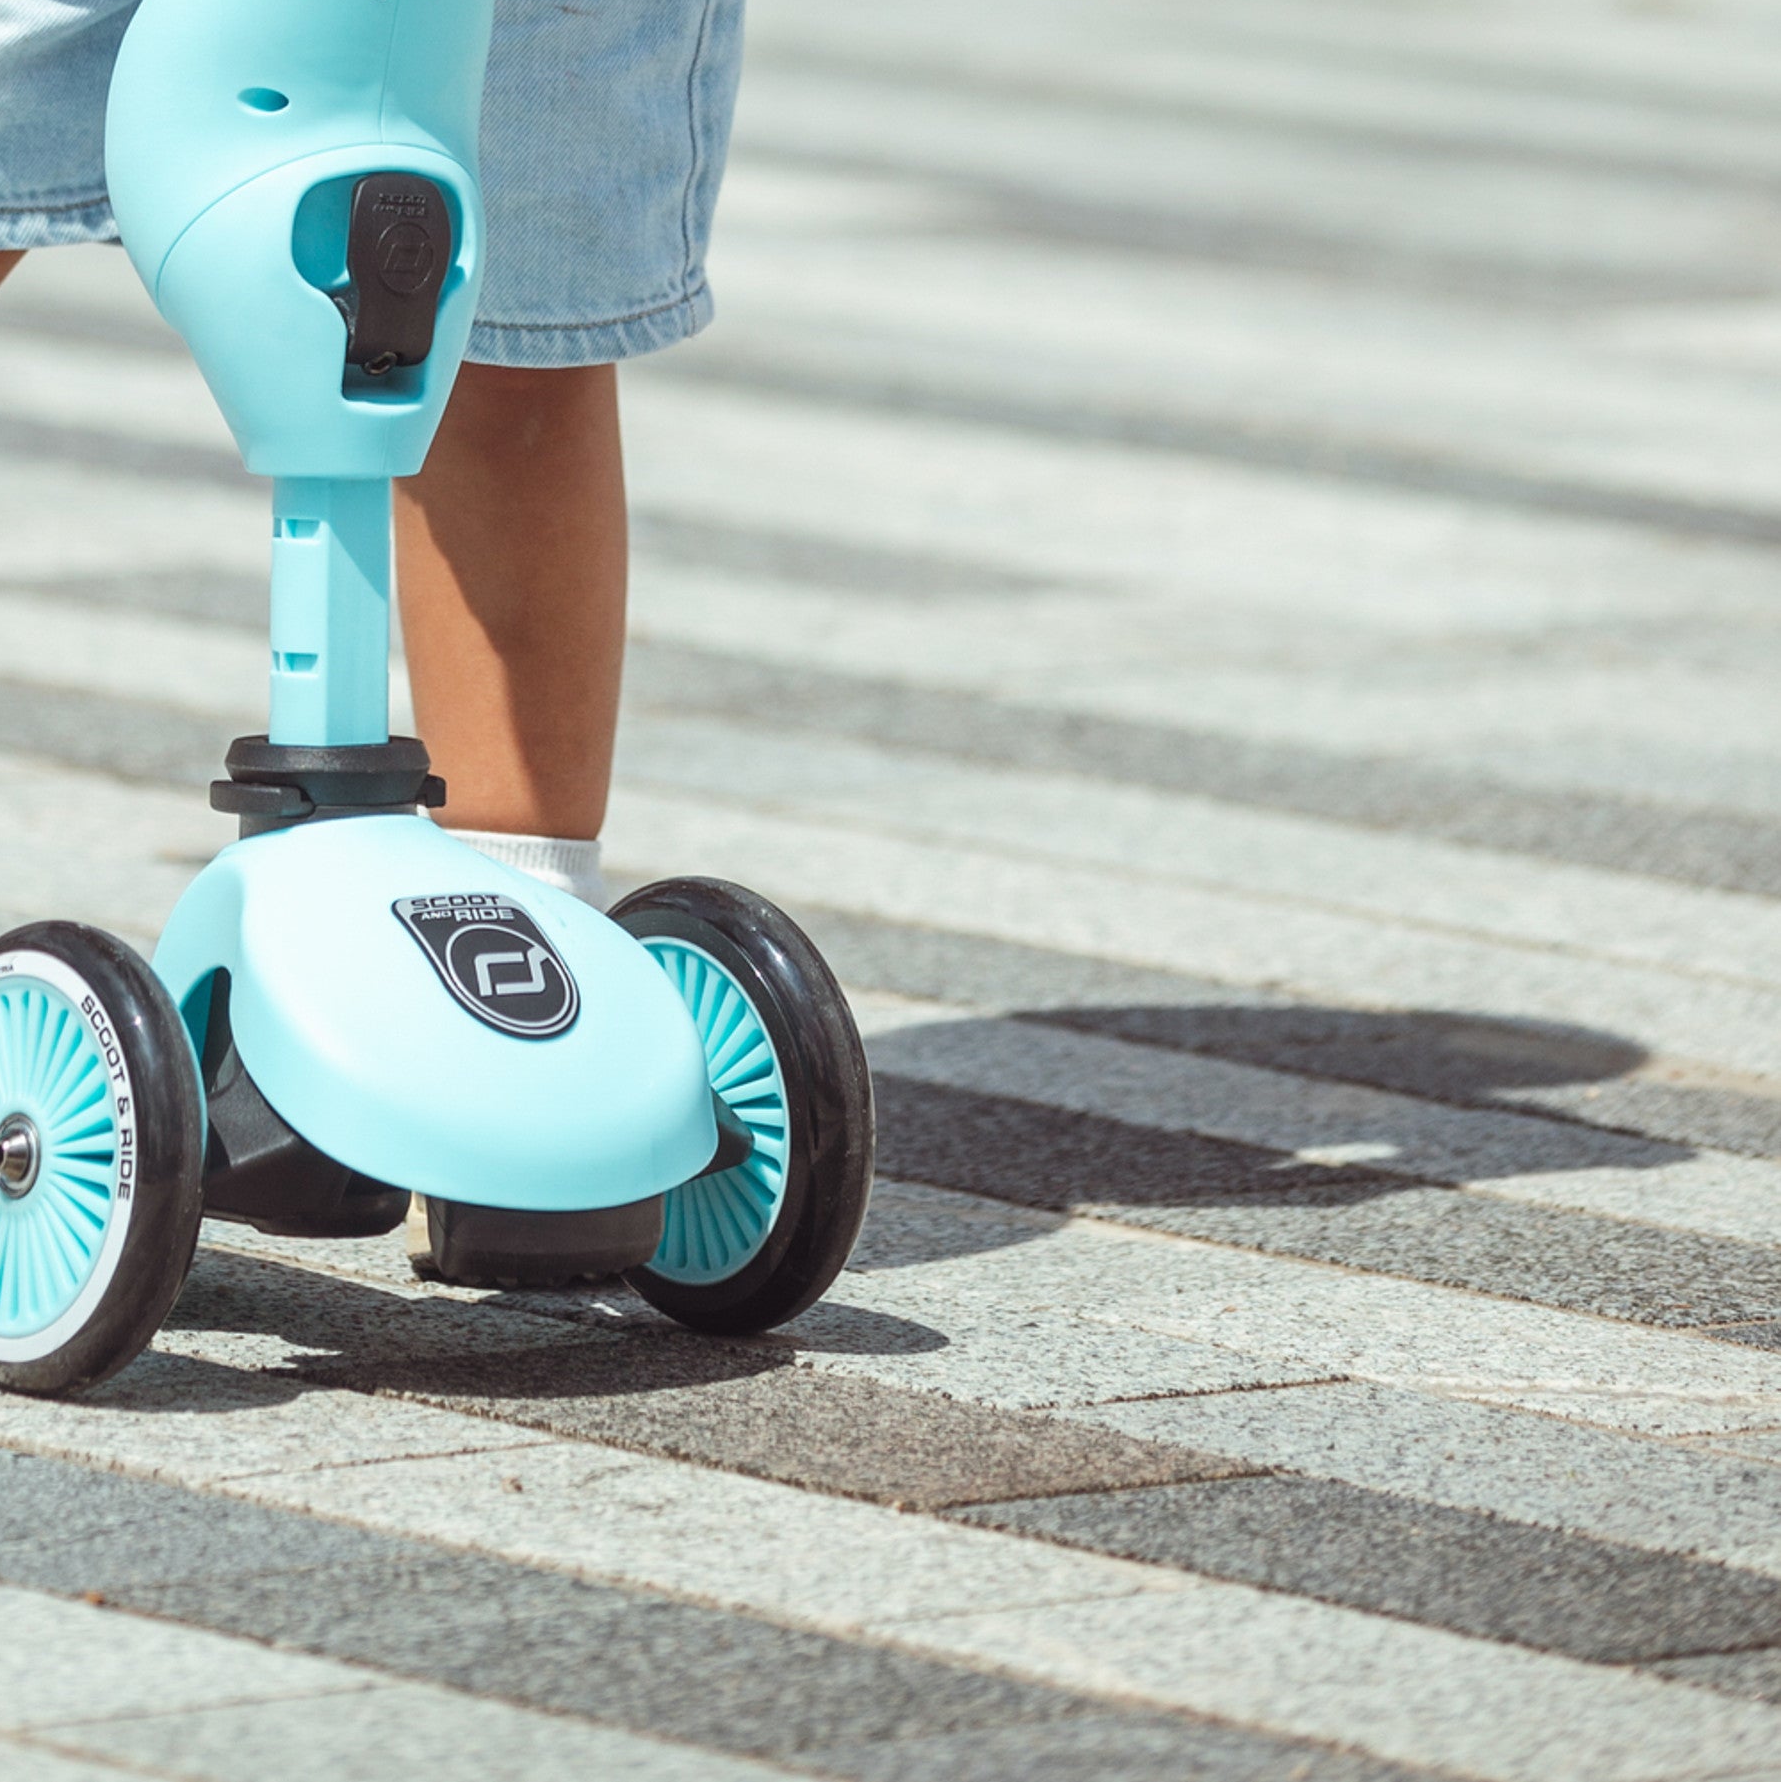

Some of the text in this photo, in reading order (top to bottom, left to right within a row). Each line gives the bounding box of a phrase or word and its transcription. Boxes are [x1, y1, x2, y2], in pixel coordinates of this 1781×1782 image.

[411, 894, 499, 911] SCOOT
[421, 908, 515, 922] AND RIDE
[81, 994, 133, 1200] SCOOT & RIDE
